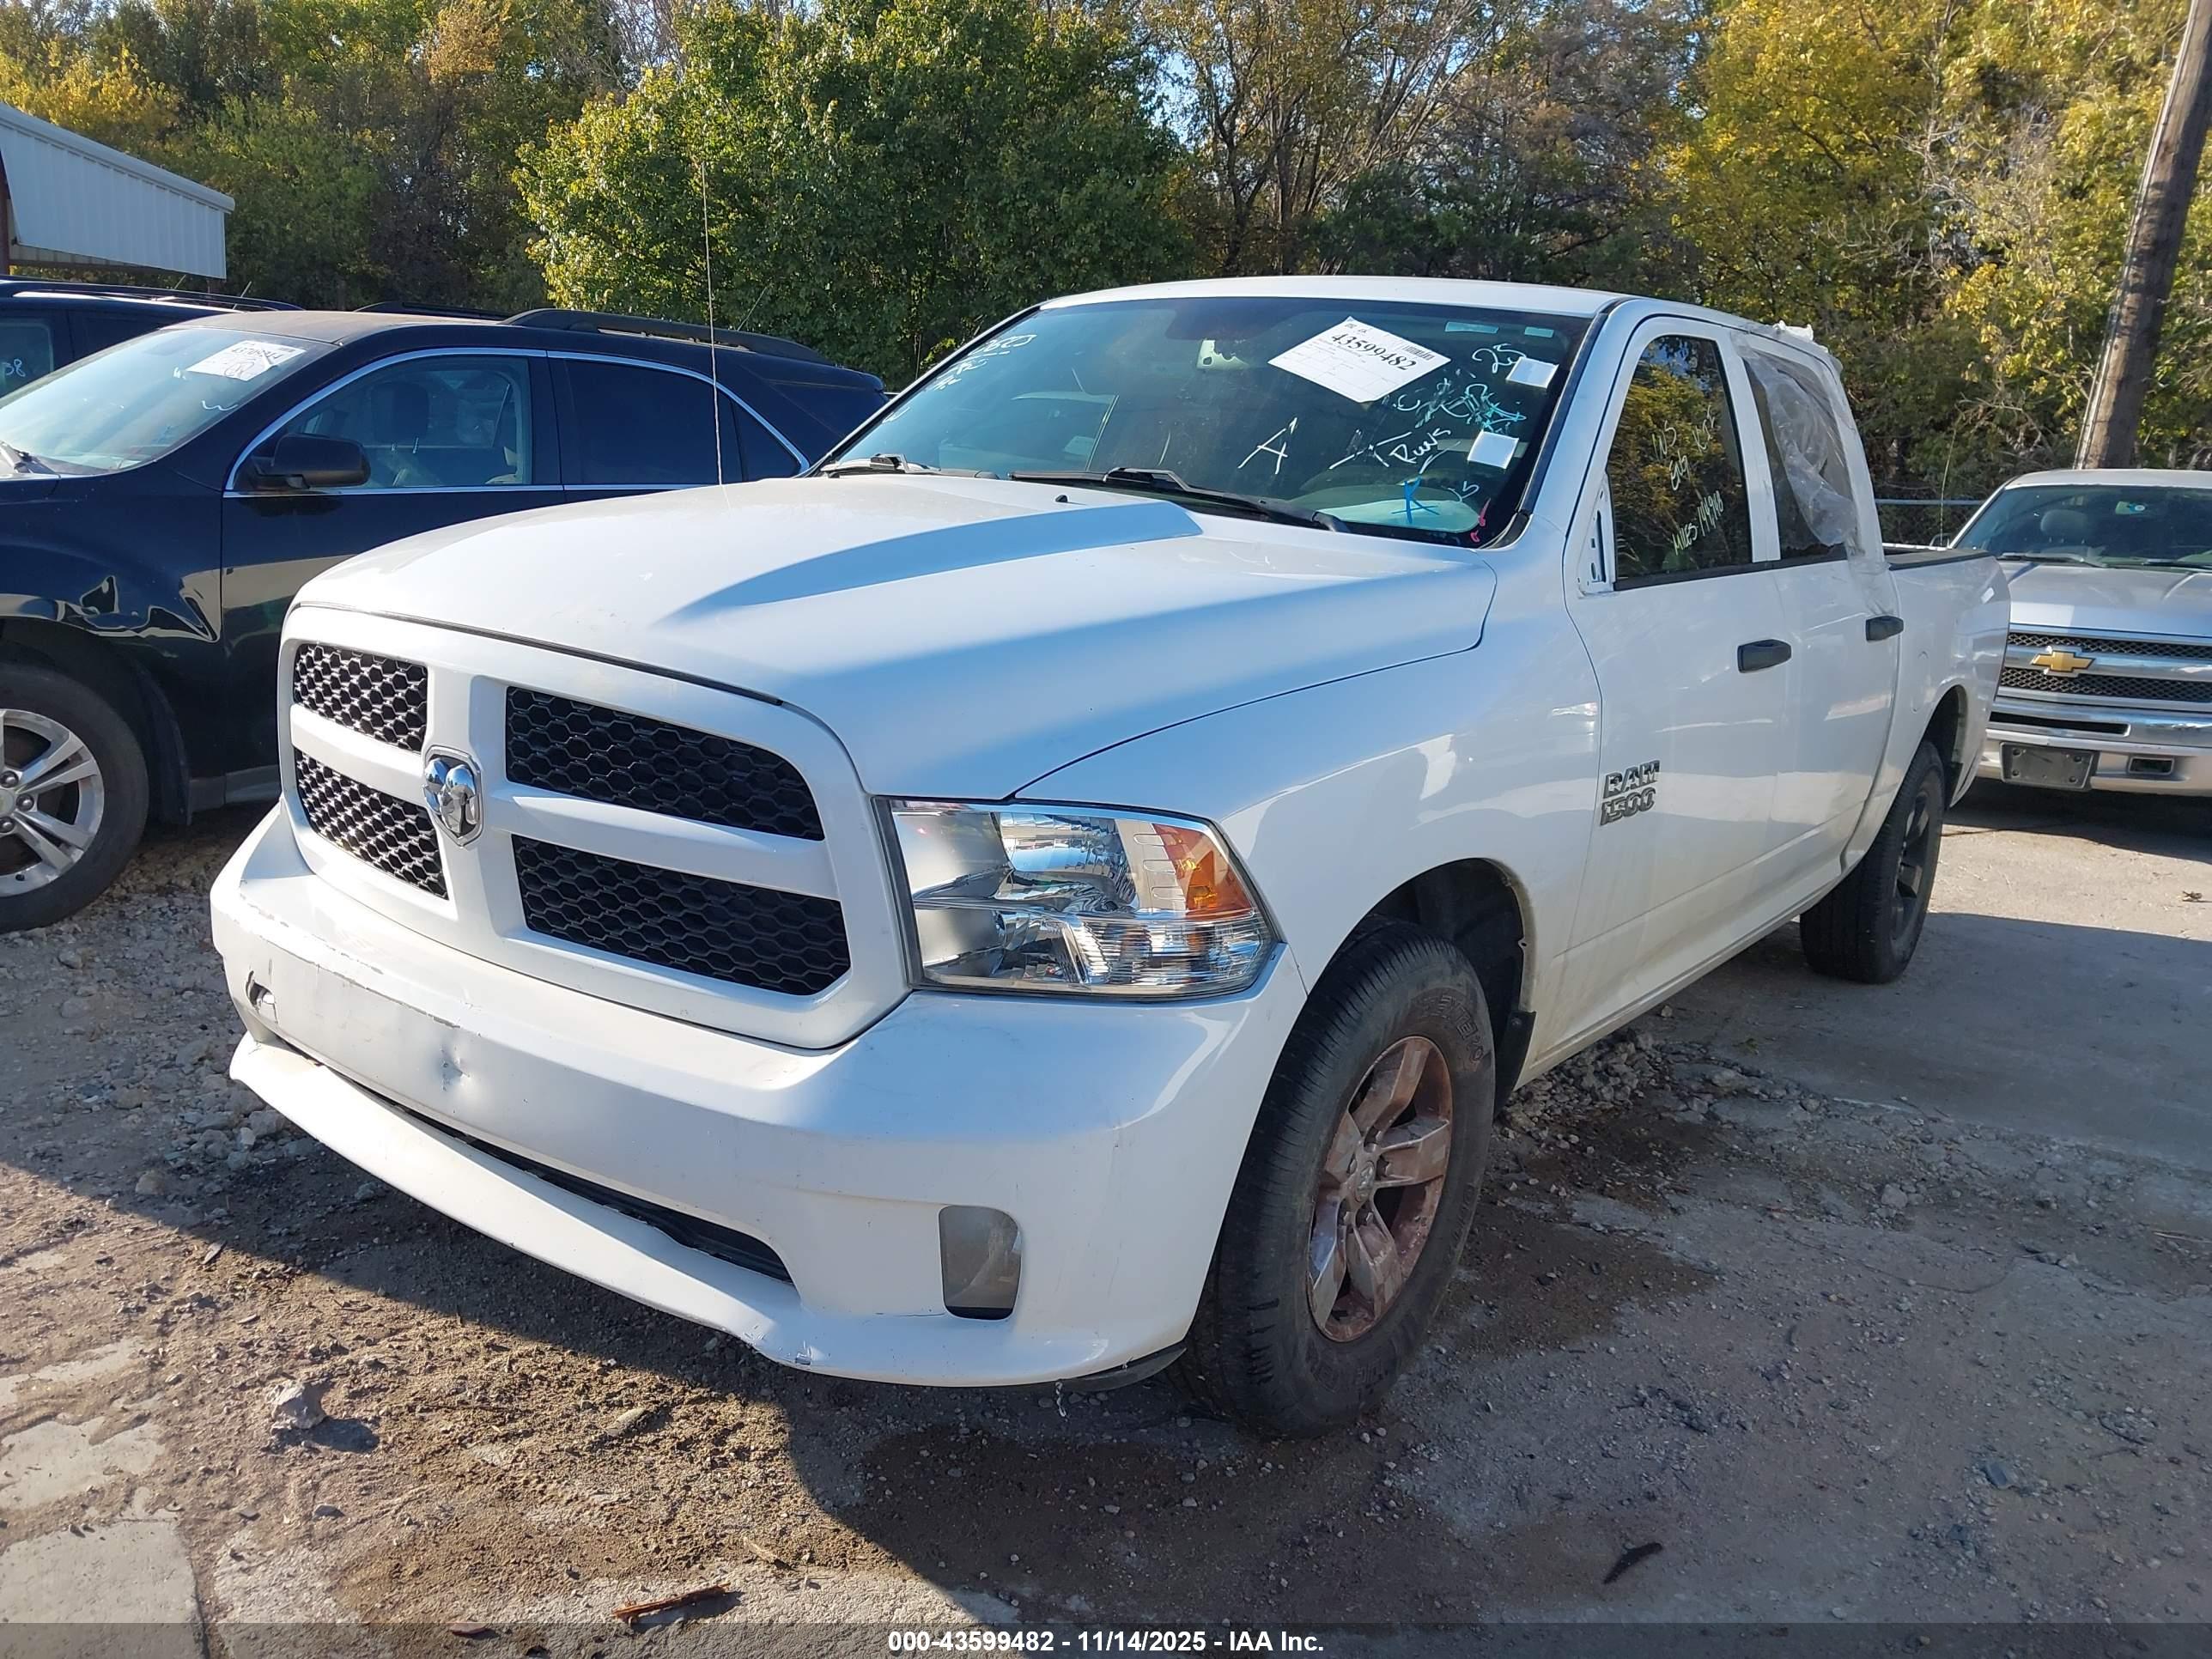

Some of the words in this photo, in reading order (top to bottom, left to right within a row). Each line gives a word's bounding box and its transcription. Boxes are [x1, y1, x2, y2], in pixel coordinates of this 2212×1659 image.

[1331, 332, 1418, 371] 43599482
[1602, 759, 1661, 799] RAM
[1600, 787, 1656, 826] 1500
